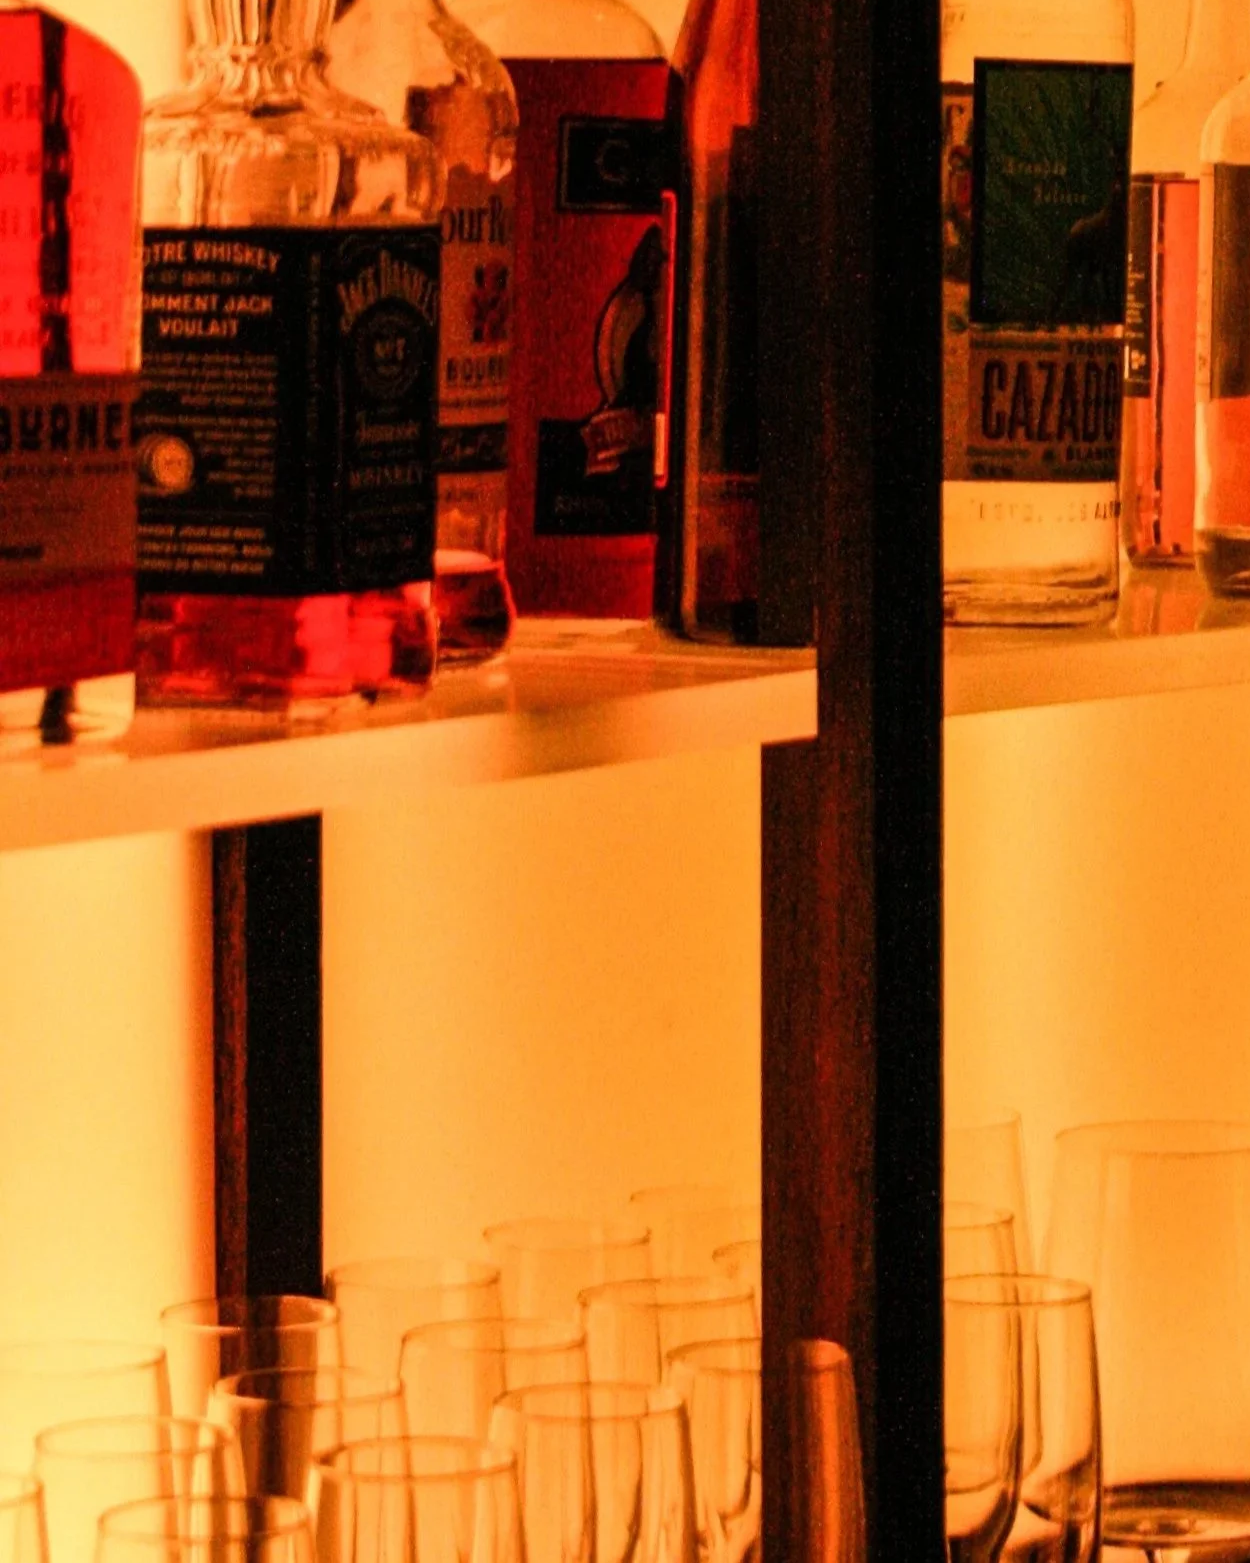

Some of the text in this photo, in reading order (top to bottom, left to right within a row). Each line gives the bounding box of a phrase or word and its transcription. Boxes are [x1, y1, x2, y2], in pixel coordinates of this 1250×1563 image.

[192, 240, 282, 274] WHISKEY
[222, 293, 274, 318] JACK
[158, 317, 240, 339] VOULAIT
